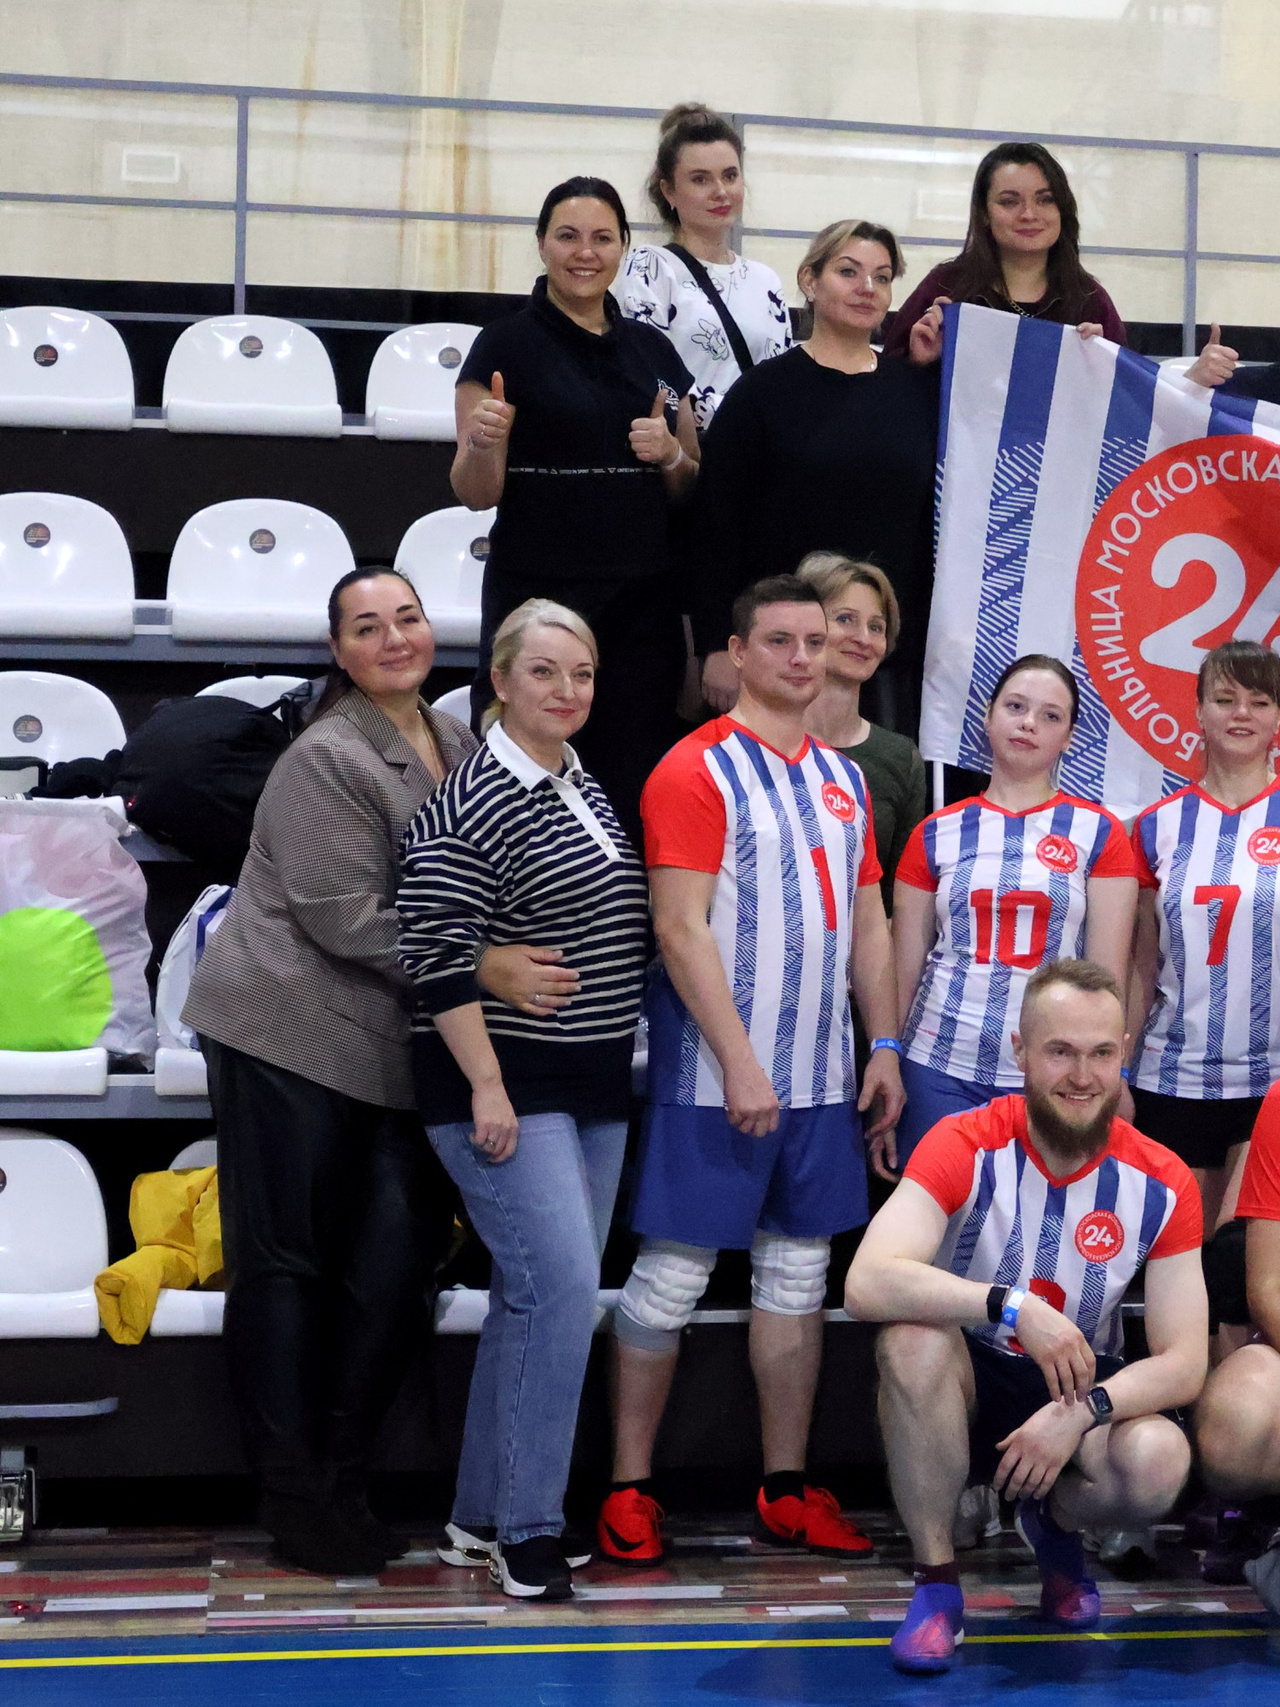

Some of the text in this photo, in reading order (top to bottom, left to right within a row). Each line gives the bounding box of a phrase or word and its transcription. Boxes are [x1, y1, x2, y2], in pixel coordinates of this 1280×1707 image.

[1090, 585, 1201, 761] БОЛЬНИЦА
[810, 846, 837, 931] 1
[1044, 845, 1072, 864] 24
[970, 888, 1053, 970] 10
[1193, 885, 1242, 966] 7
[1083, 1224, 1115, 1247] 24
